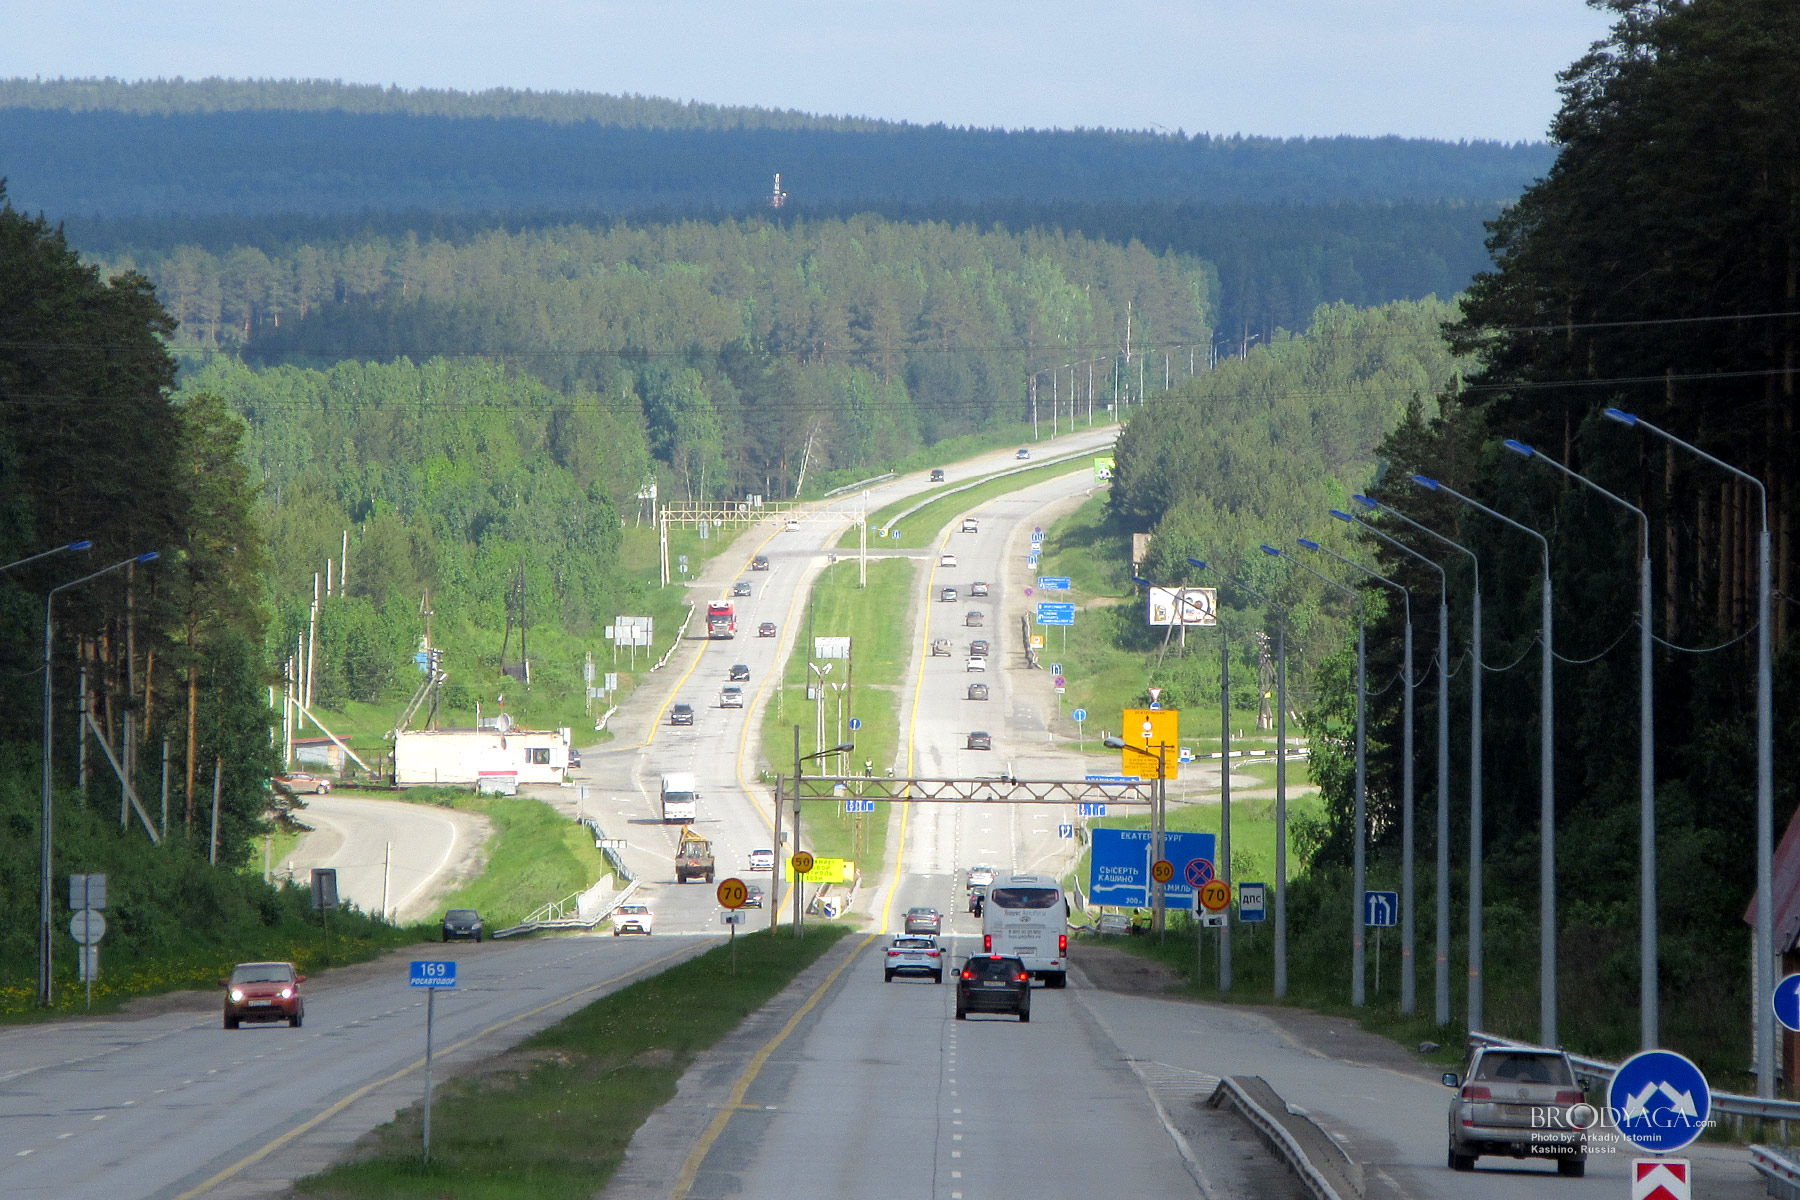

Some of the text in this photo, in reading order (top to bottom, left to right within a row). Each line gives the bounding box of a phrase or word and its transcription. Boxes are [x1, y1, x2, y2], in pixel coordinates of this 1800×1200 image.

[1120, 831, 1183, 842] ЕКАТЕРБУРГ
[795, 857, 810, 867] 50
[1099, 865, 1139, 875] СЫСЕРТЬ
[1156, 866, 1170, 877] 50
[1098, 874, 1134, 883] КАШИНО
[724, 887, 742, 900] 70
[1206, 889, 1225, 902] 70
[1242, 895, 1262, 905] ДПС
[420, 963, 446, 977] 169
[410, 977, 455, 985] РОСАВТОДОР
